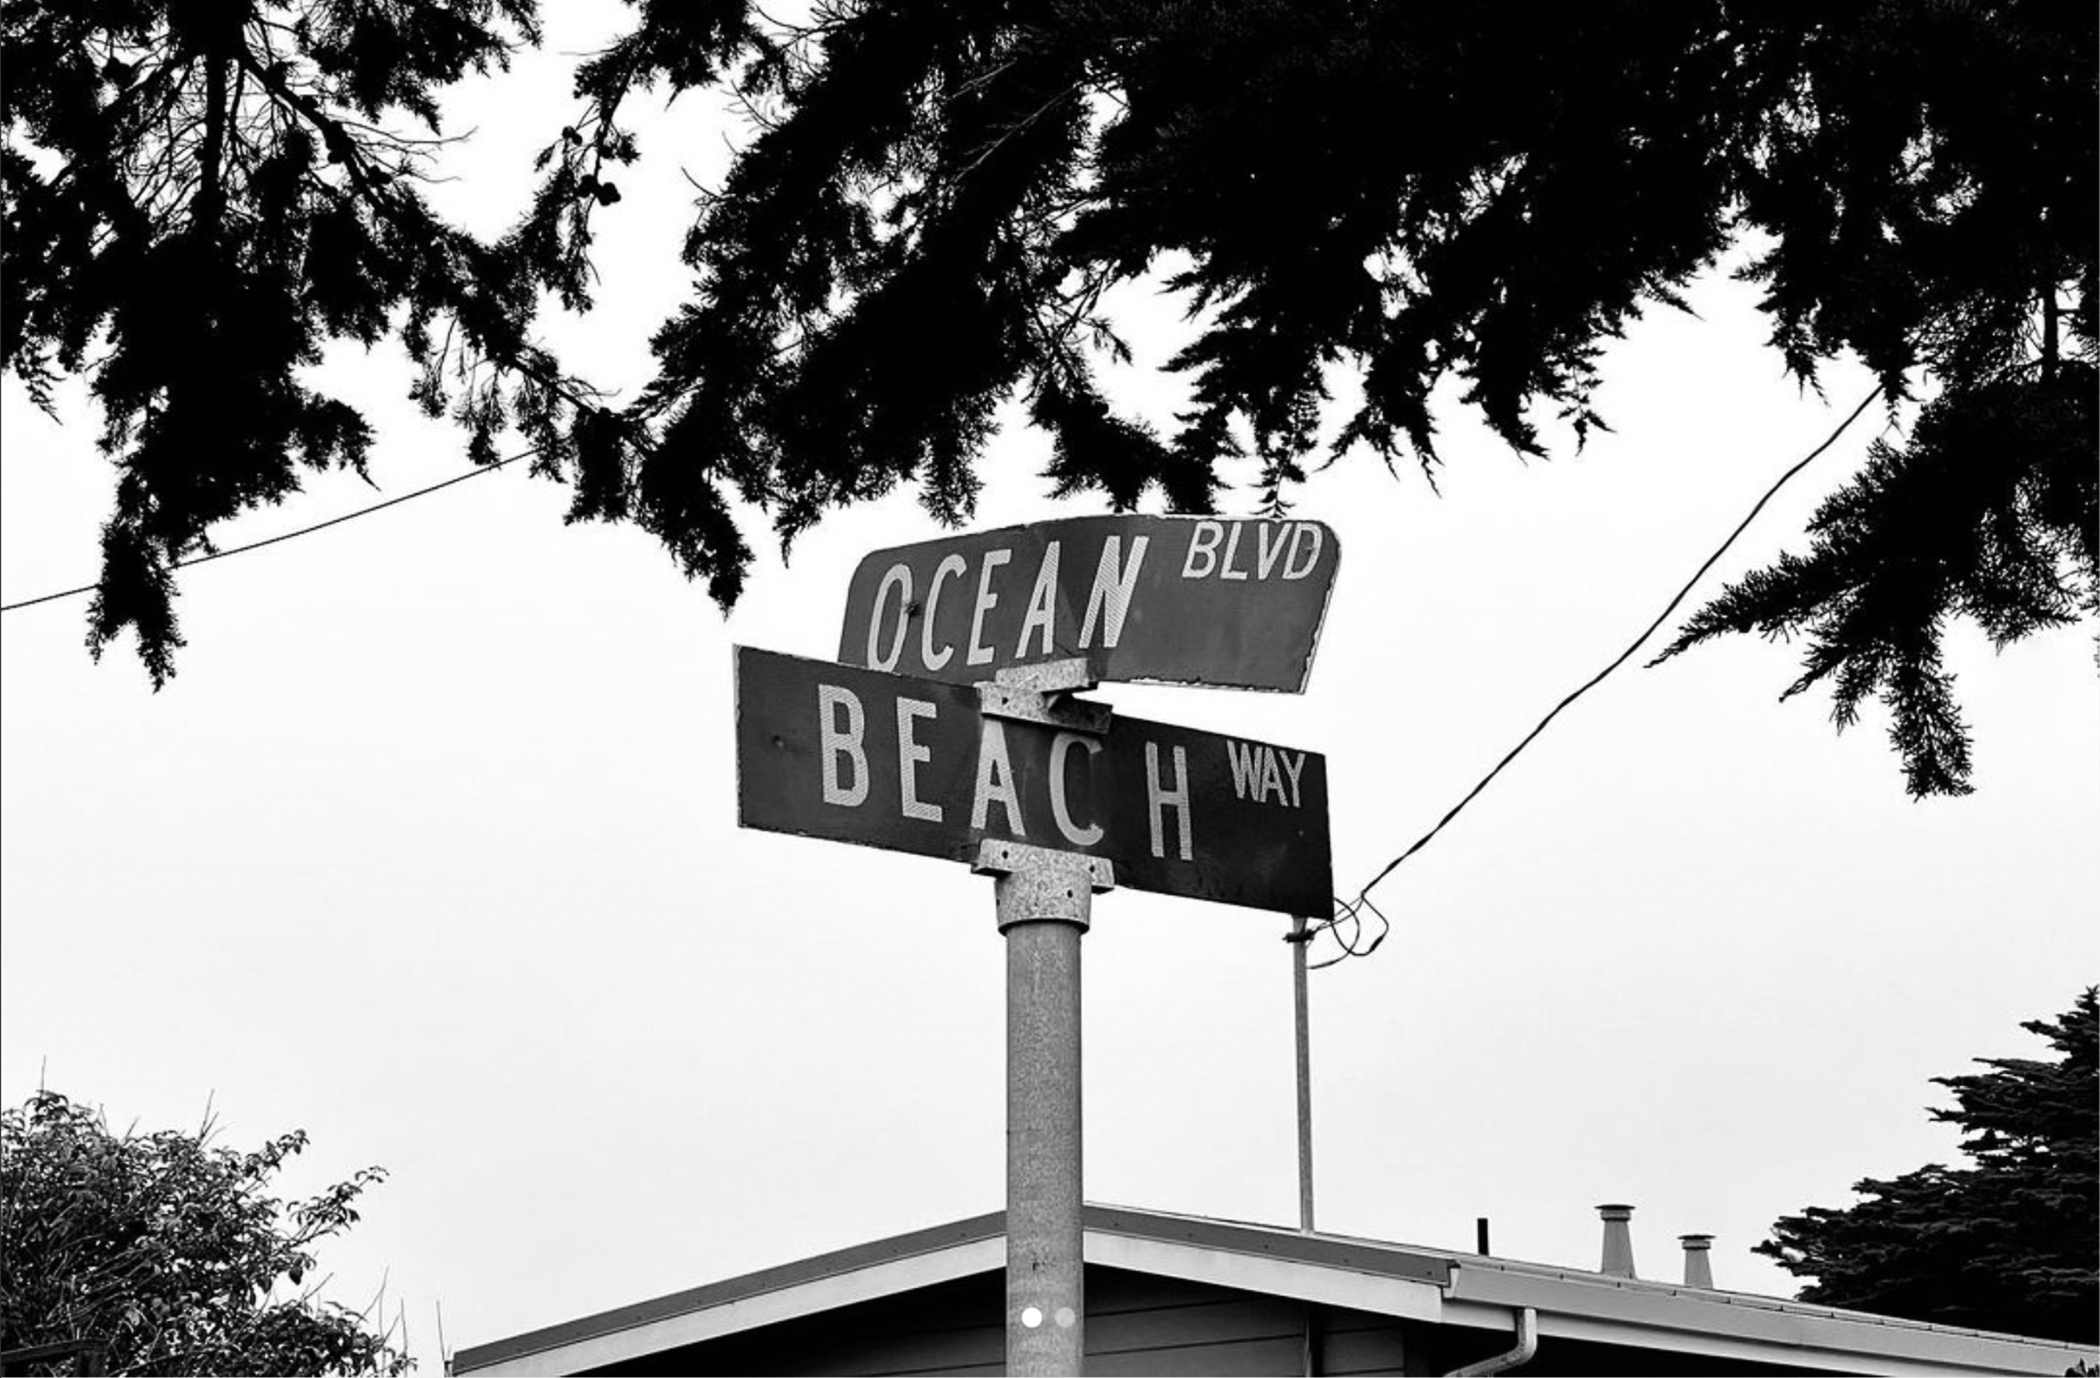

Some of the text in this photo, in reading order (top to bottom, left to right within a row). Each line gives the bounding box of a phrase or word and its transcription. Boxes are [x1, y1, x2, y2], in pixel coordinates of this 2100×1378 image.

[867, 521, 1323, 671] OCEAN BLVD
[818, 684, 1306, 861] BEACH WAY
